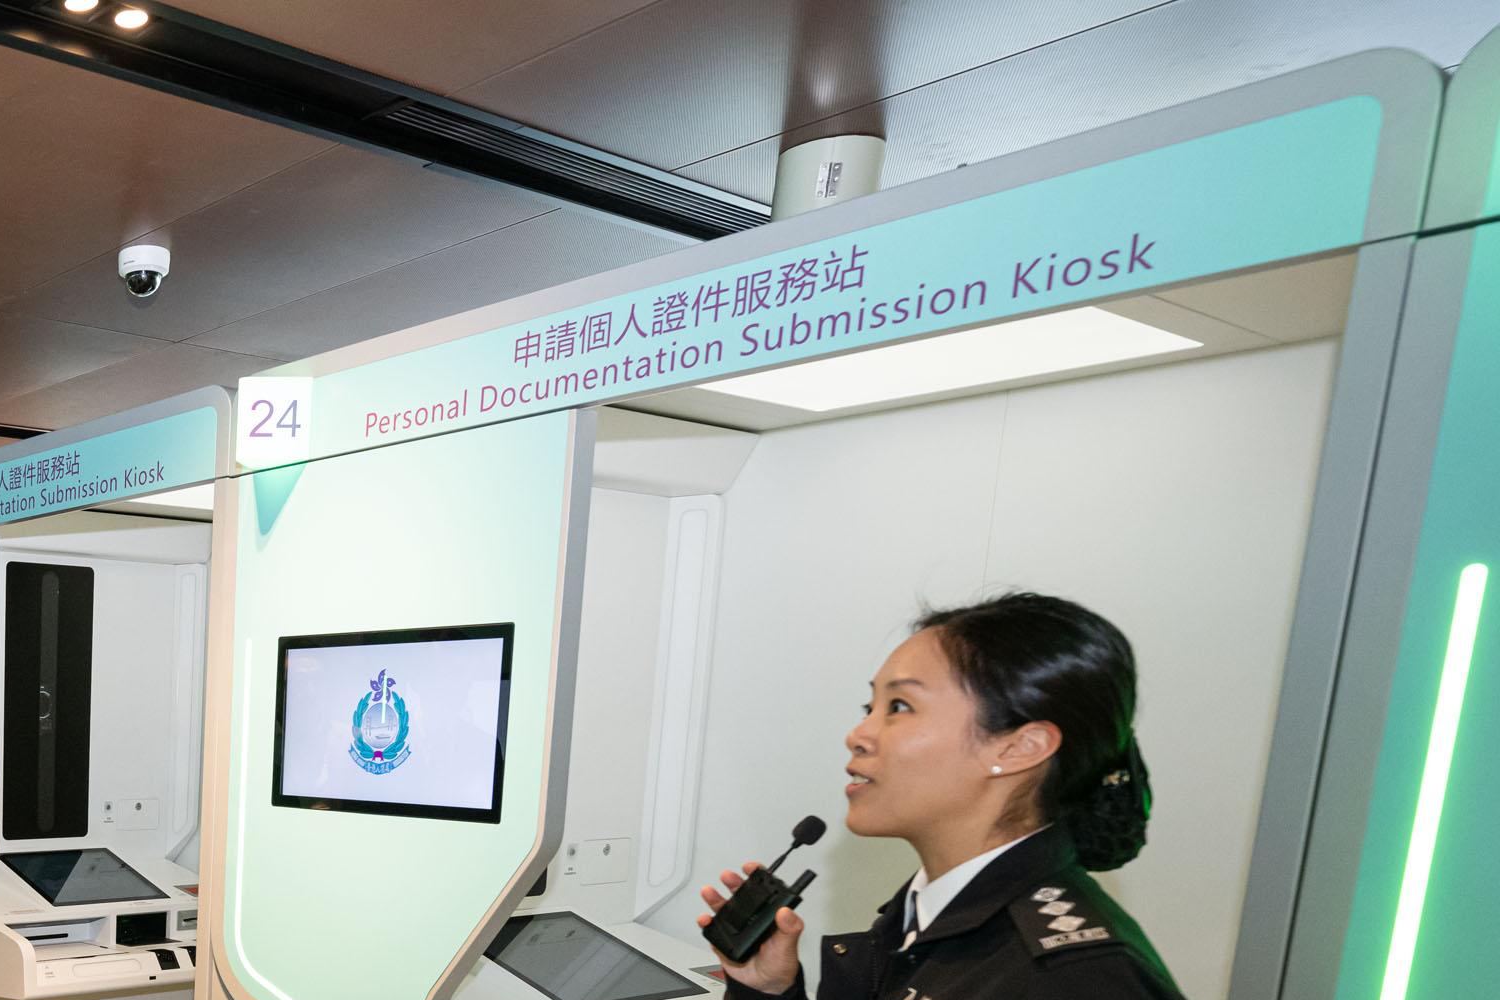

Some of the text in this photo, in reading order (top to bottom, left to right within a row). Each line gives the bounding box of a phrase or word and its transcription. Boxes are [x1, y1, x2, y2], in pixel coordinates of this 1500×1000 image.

[364, 233, 1157, 438] Personal Documentation Submission Kiosk
[513, 243, 870, 370] 申請個人證件服務站
[249, 399, 301, 438] 24
[40, 476, 119, 507] Submission
[124, 460, 165, 489] Kiosk
